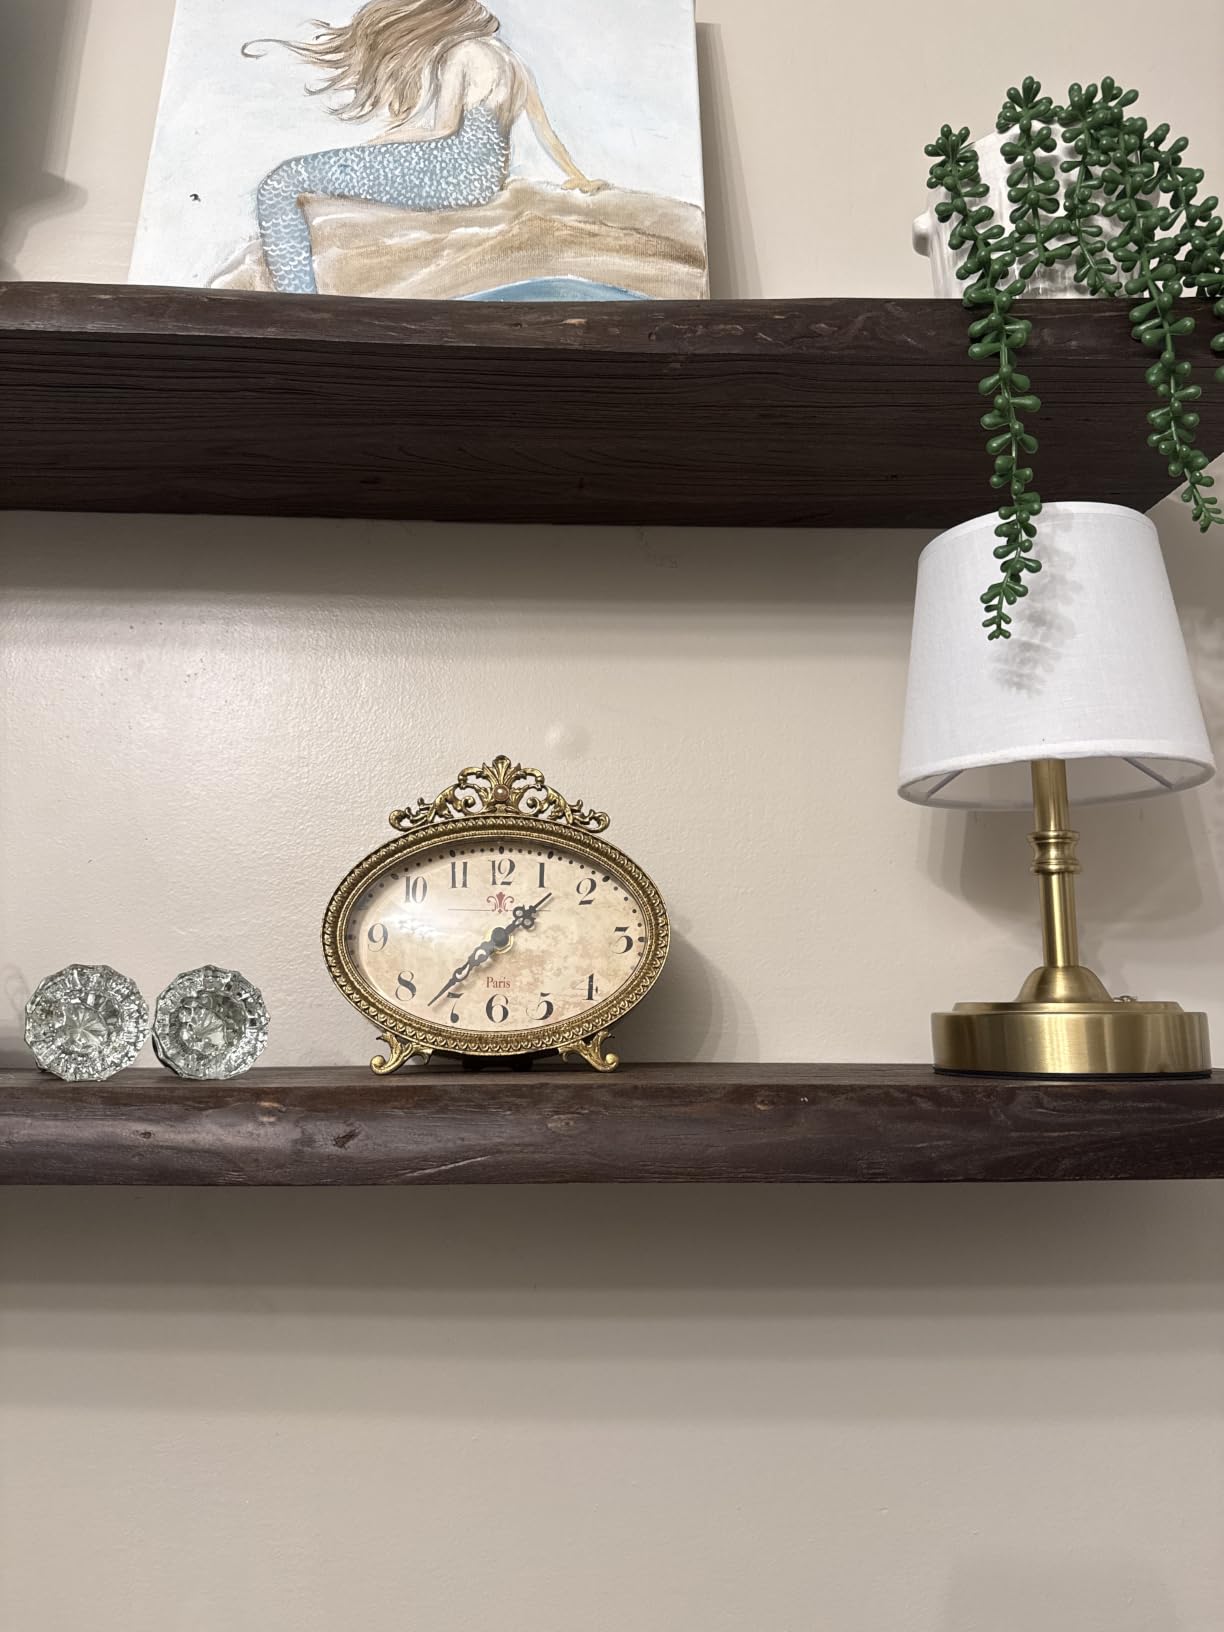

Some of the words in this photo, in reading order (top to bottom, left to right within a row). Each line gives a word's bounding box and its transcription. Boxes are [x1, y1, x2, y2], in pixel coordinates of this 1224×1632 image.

[451, 861, 468, 889] 11
[487, 858, 516, 886] 12
[537, 861, 546, 889] 1
[404, 875, 428, 903] 10
[576, 877, 597, 906] 2
[367, 922, 389, 952] 9
[611, 926, 634, 954] 3
[395, 970, 417, 1001] 8
[486, 976, 512, 989] Paris
[575, 973, 599, 1001] 4
[447, 992, 464, 1024] 7
[485, 993, 509, 1024] 6
[525, 992, 554, 1021] 5
